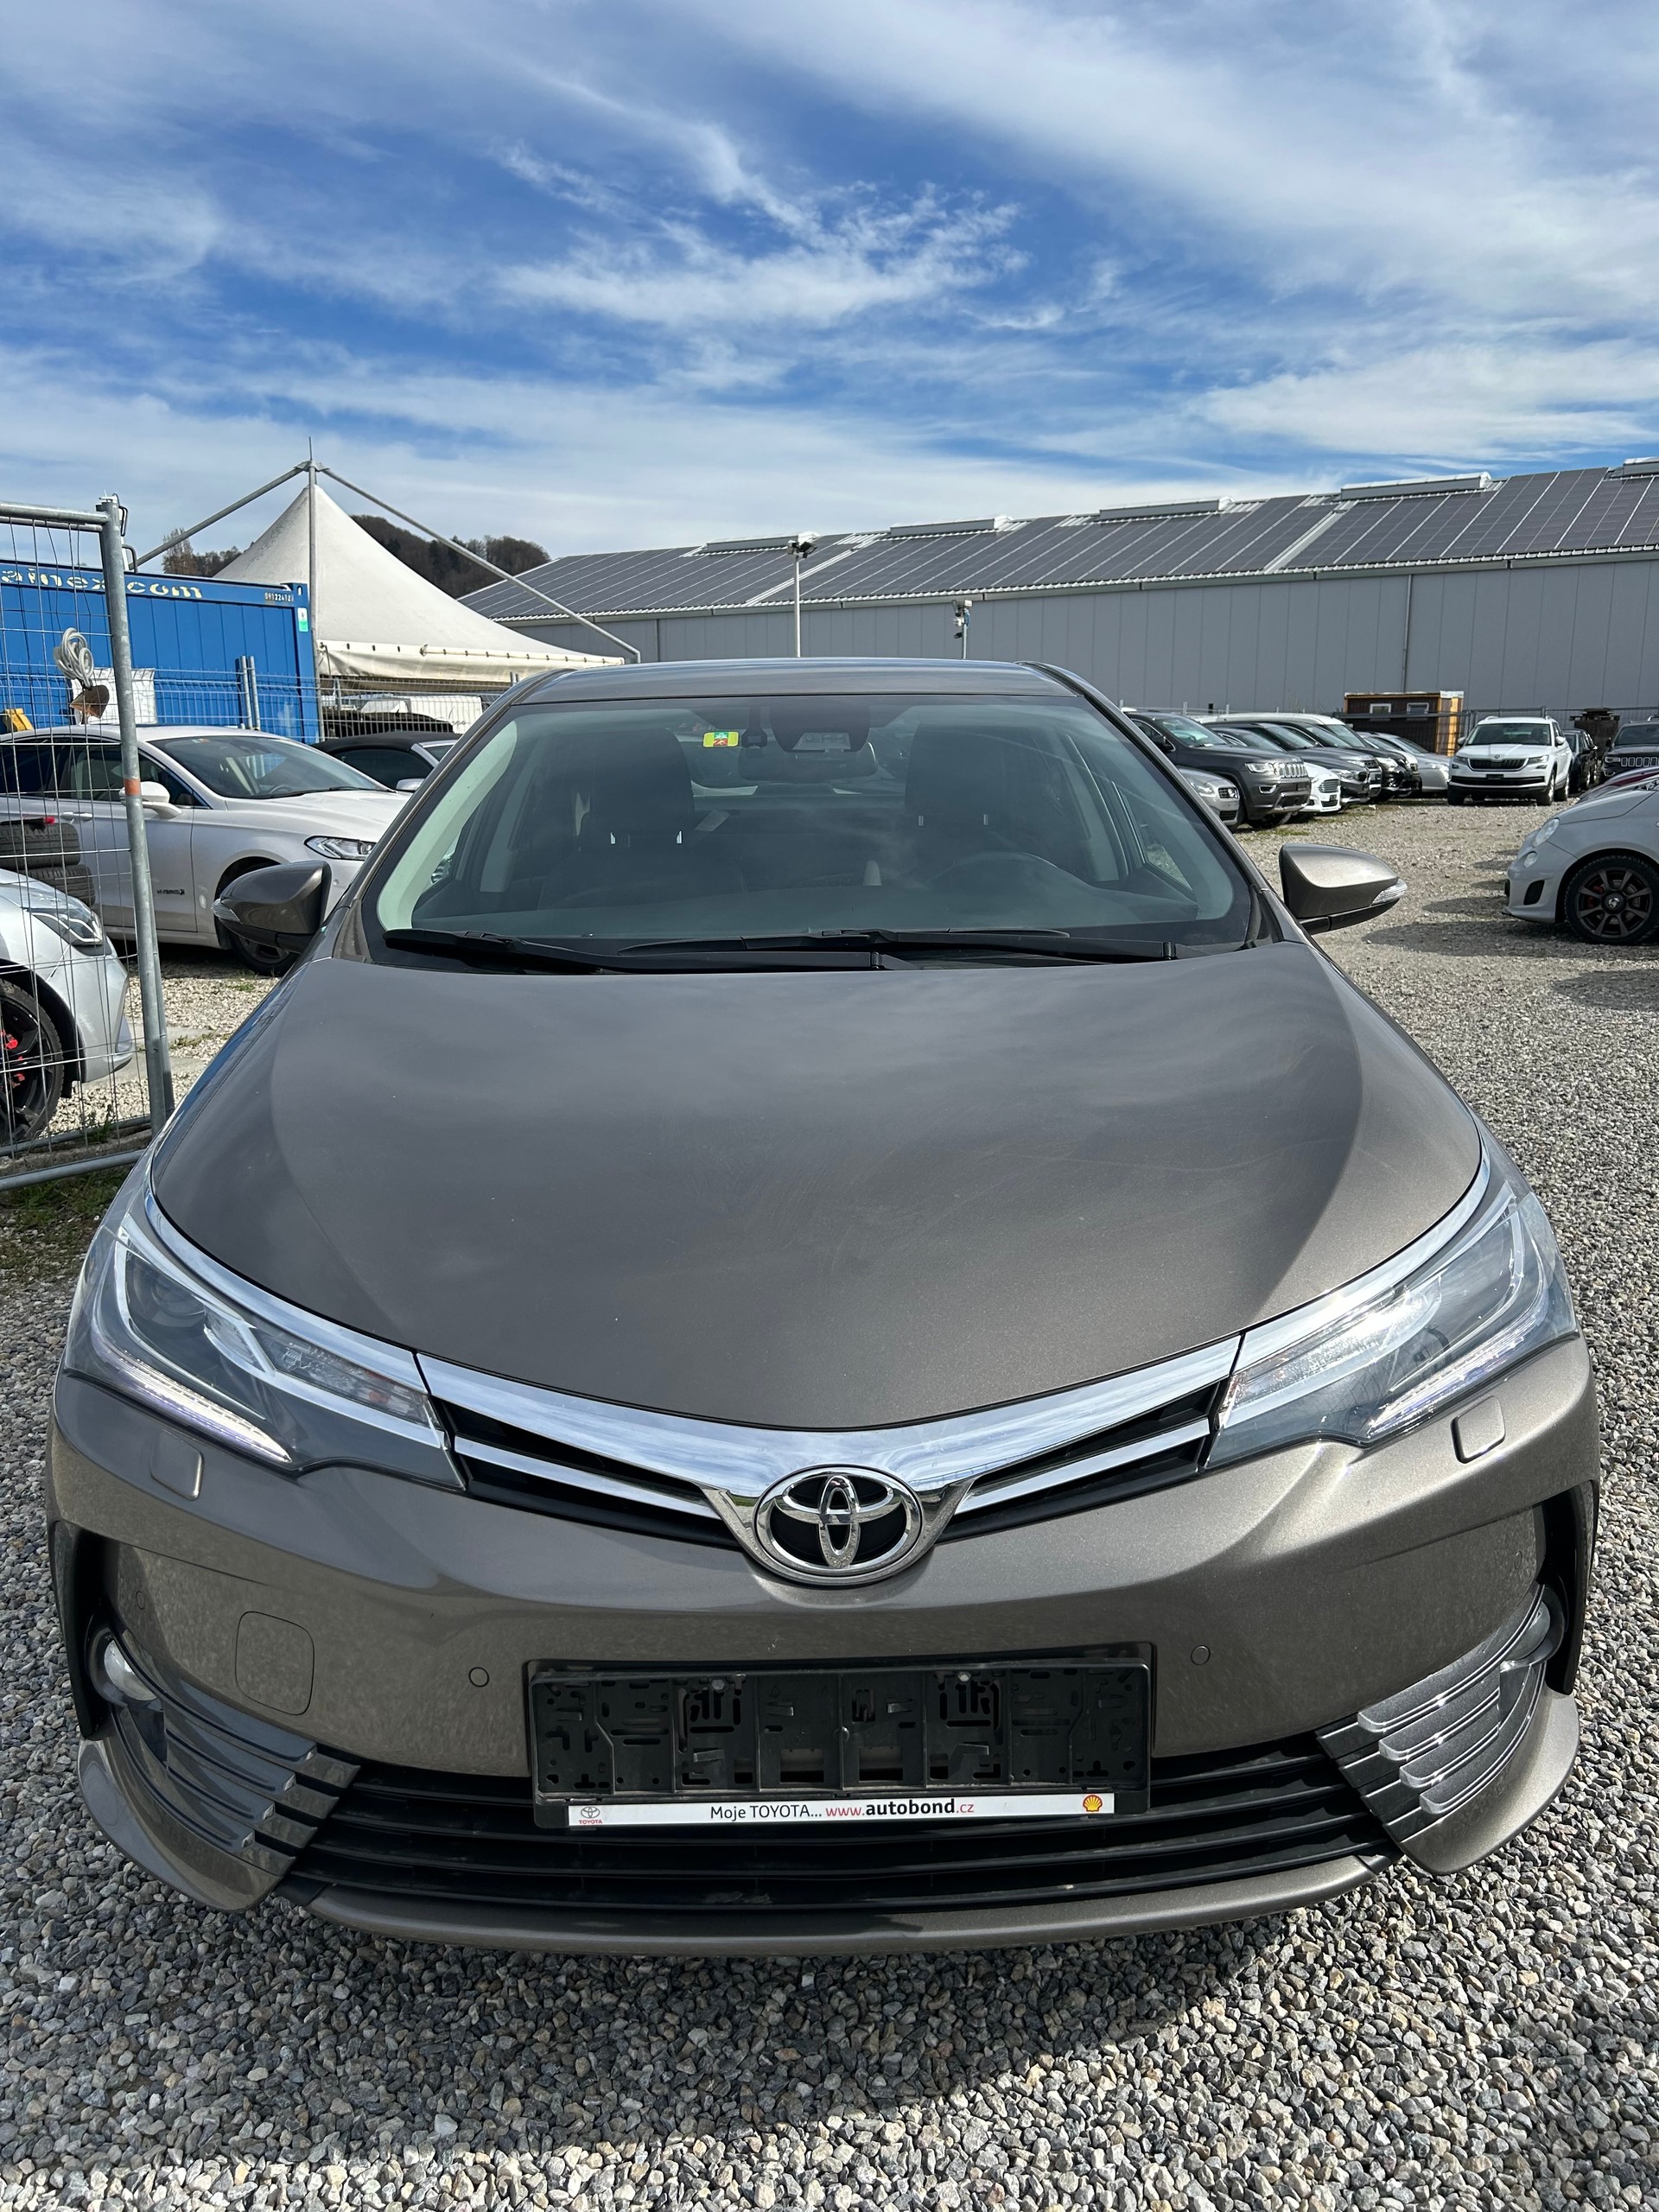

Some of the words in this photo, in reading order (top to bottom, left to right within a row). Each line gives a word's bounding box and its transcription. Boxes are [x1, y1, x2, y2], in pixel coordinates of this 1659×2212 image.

[710, 1805, 747, 1821] Moje
[749, 1804, 823, 1818] TOYOTA...
[825, 1798, 975, 1817] www.autobond.cz
